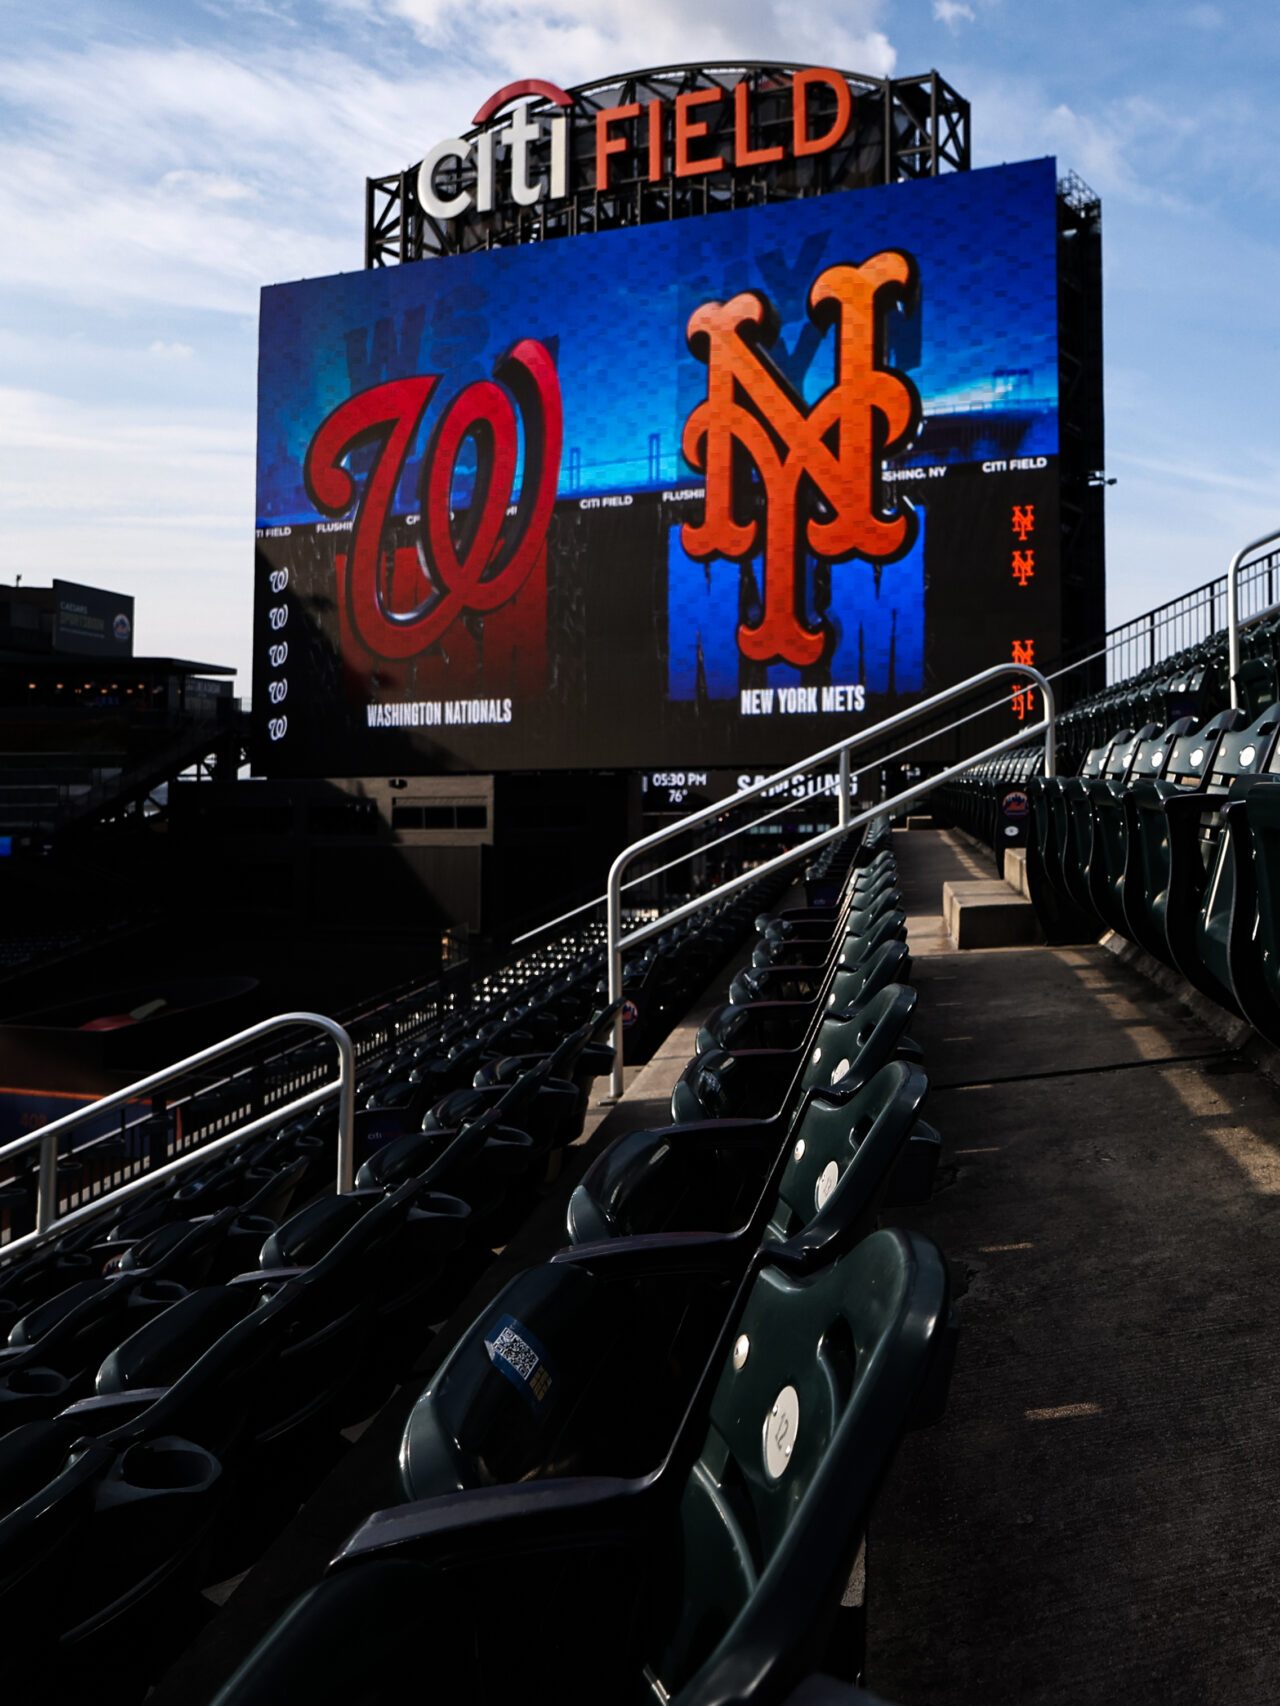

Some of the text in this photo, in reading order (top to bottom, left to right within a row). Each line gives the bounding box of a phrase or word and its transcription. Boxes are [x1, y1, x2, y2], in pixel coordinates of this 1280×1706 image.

[418, 67, 852, 220] citi FIELD
[928, 466, 947, 478] NY
[982, 457, 1047, 473] CITI FIELD
[579, 495, 634, 510] CITI FIELD
[662, 488, 705, 502] FLUSHI
[265, 527, 292, 538] FIELD
[741, 684, 865, 715] NEW YORK METS
[367, 698, 512, 728] WASHINGTON NATIONALS
[652, 772, 686, 787] 05:30
[687, 772, 707, 786] PM
[775, 1412, 789, 1450] 12
